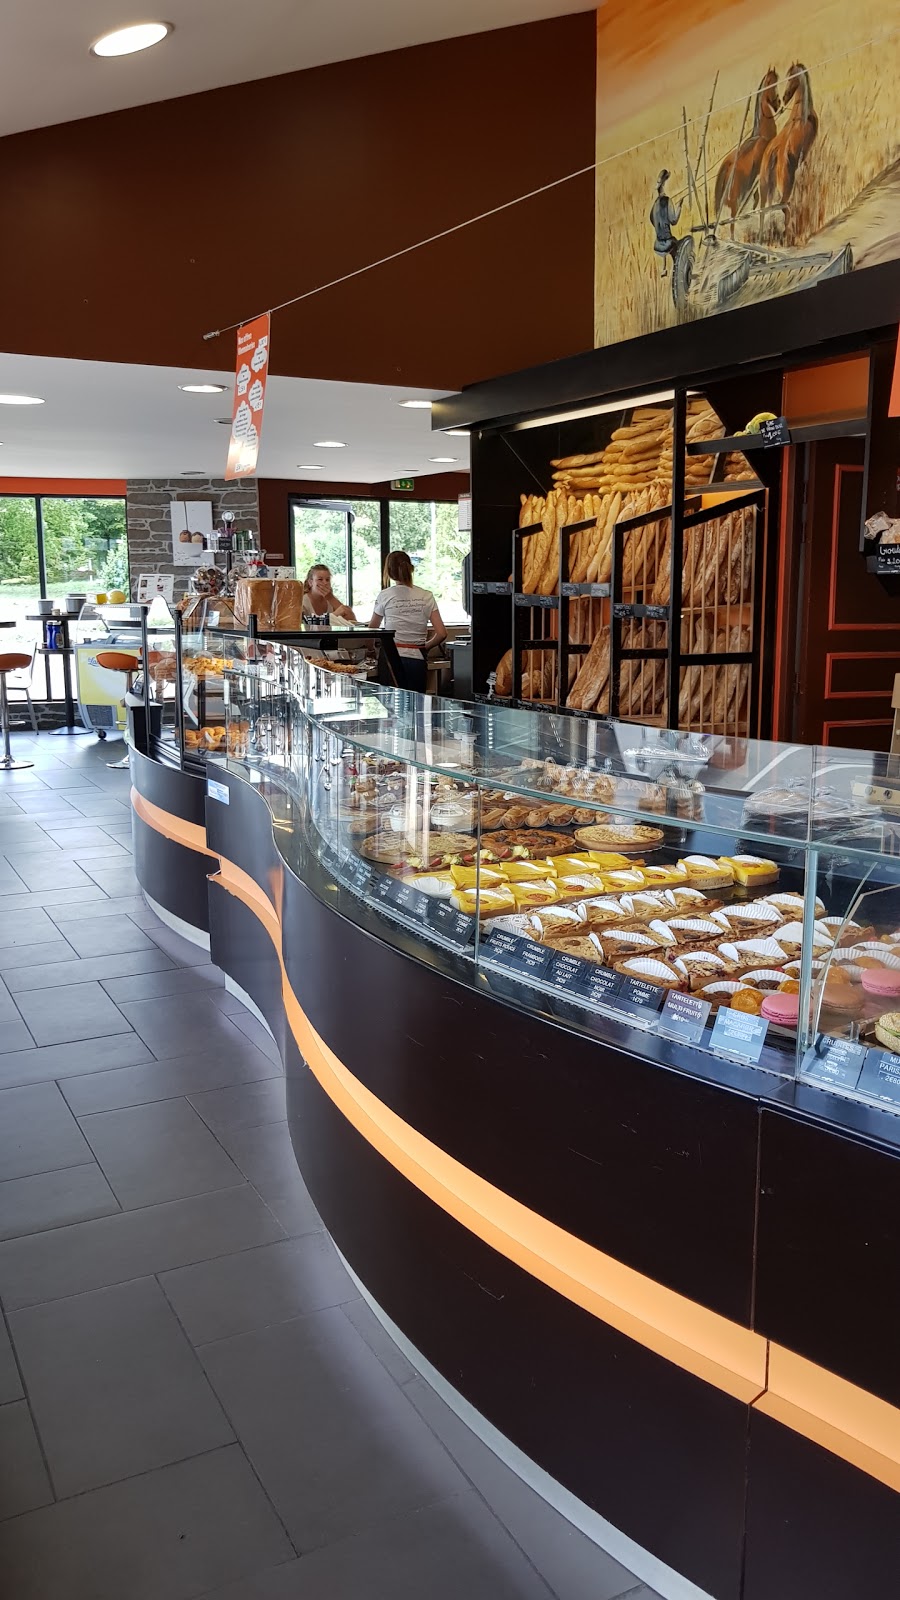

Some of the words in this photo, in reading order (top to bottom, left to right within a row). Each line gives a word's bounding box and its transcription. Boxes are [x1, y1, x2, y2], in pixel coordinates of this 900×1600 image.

[561, 955, 581, 966] CRUMBLE
[555, 961, 579, 973] CHOCOLAT
[594, 968, 616, 980] CRUMBLE
[590, 975, 615, 988] CHOCOLAT
[629, 978, 659, 993] TARTELETTE
[632, 988, 651, 999] POMME
